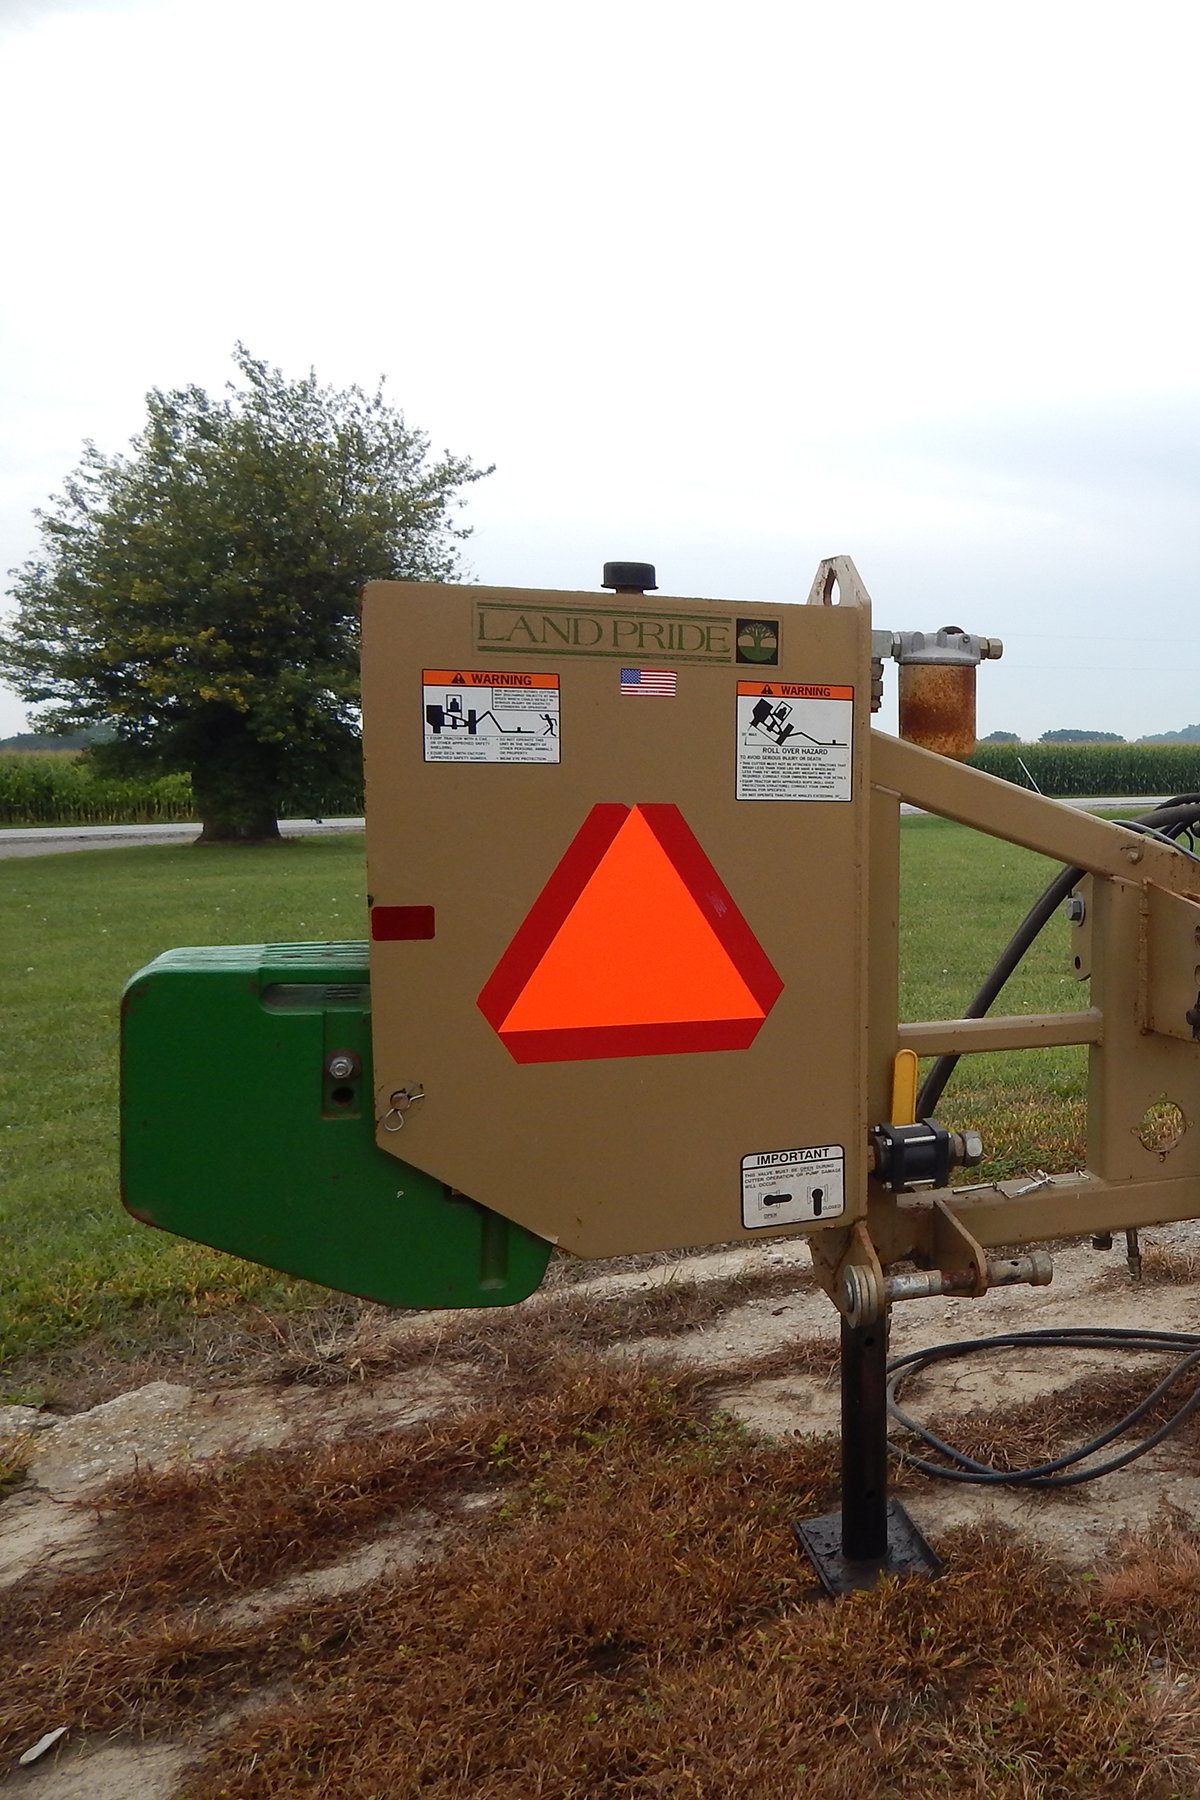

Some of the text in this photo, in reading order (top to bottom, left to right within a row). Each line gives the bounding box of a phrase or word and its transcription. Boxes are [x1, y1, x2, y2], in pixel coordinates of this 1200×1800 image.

[478, 612, 731, 653] LAND PRIDE
[472, 674, 532, 686] WARNING
[781, 686, 831, 696] WARNING
[757, 1148, 829, 1165] IMPORTANT
